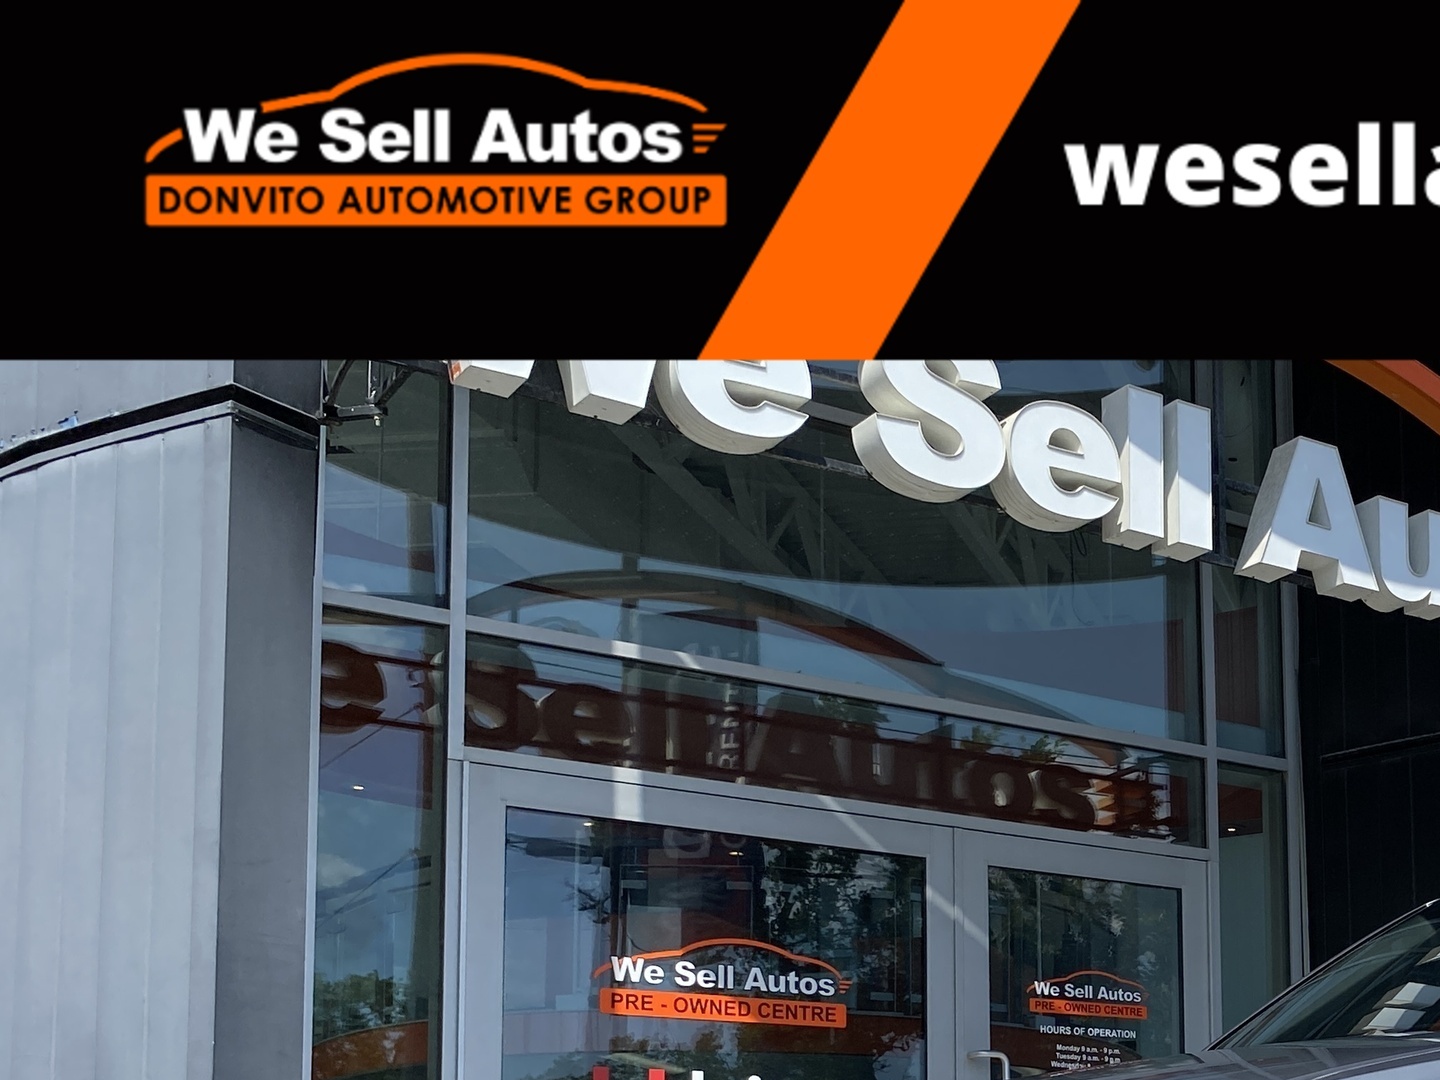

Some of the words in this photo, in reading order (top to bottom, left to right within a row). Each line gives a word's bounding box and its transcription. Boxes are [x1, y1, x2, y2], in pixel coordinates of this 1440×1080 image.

[851, 360, 1213, 562] Sell
[610, 955, 665, 985] We
[674, 960, 735, 990] Sell
[744, 966, 836, 997] Autos
[1034, 980, 1060, 996] We
[1064, 983, 1092, 999] Sell
[1097, 986, 1141, 1002] Autos
[610, 992, 654, 1012] PRE
[673, 996, 750, 1017] OWNED
[758, 1002, 837, 1023] CENTRE
[1034, 1001, 1055, 1011] PRE
[1065, 1002, 1100, 1014] OWNED
[1103, 1005, 1142, 1016] CENTRE
[1040, 1024, 1071, 1035] HOURS
[1073, 1026, 1085, 1035] OF
[1087, 1027, 1136, 1038] OPERATION
[1056, 1043, 1080, 1053] Monday
[1056, 1052, 1081, 1062] Tuesday
